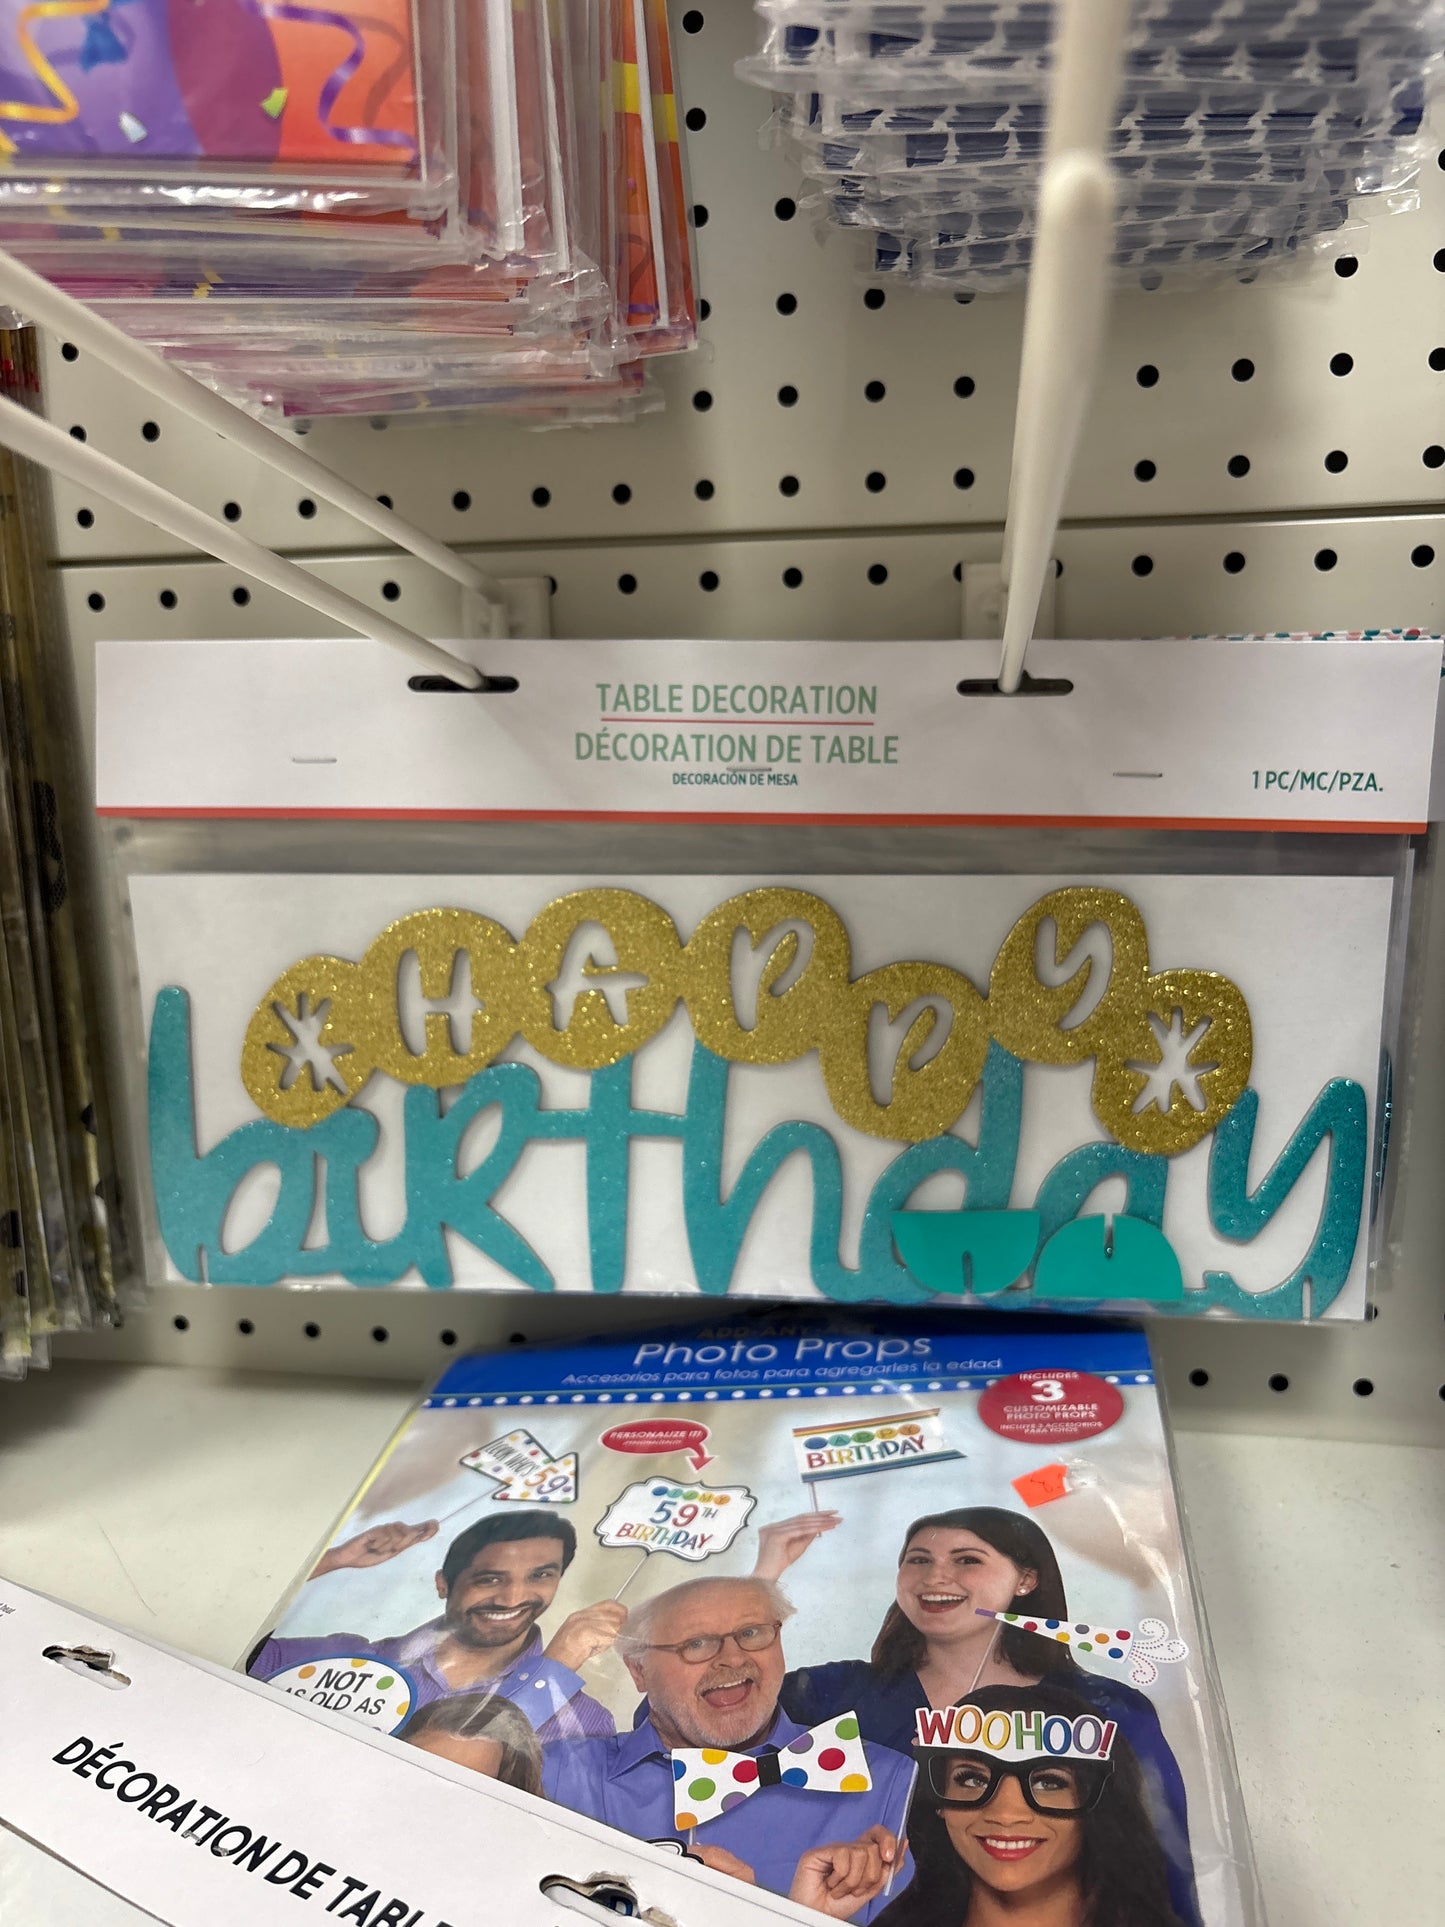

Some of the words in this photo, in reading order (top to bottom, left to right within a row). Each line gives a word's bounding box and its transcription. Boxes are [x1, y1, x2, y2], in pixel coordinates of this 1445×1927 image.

[596, 683, 683, 713] TABLE
[692, 684, 877, 715] DECORATION
[575, 726, 756, 762] DÉCORATION
[766, 734, 802, 763] DE
[810, 735, 899, 764] TABLE
[672, 771, 746, 786] DECORACIÓN
[750, 773, 765, 786] DE
[767, 773, 798, 786] MESA
[1252, 770, 1259, 790] 1
[1265, 769, 1384, 793] PC/MC/PZA.
[632, 1340, 778, 1366] Photo
[795, 1338, 932, 1362] Props
[561, 1371, 660, 1385] Accesorios
[663, 1371, 710, 1384] para
[713, 1368, 759, 1380] fotos
[763, 1367, 810, 1380] para
[923, 1360, 941, 1372] la
[946, 1358, 1002, 1370] edad
[1019, 1371, 1080, 1380] INCLUDES
[1031, 1380, 1066, 1402] 3
[1003, 1403, 1098, 1413] CUSTOMIZABLE
[1006, 1412, 1050, 1420] PHOTO
[1055, 1411, 1096, 1419] PROPS
[806, 1435, 924, 1468] BIRTHDAY
[524, 1466, 570, 1494] 59
[615, 1522, 713, 1549] BIRTHDAY
[314, 1668, 373, 1693] NOT
[310, 1691, 352, 1711] OLD
[354, 1697, 386, 1715] AS
[918, 1706, 1115, 1758] WOOHOO!
[52, 1736, 281, 1873] DÉCORATION
[264, 1849, 337, 1900] DE
